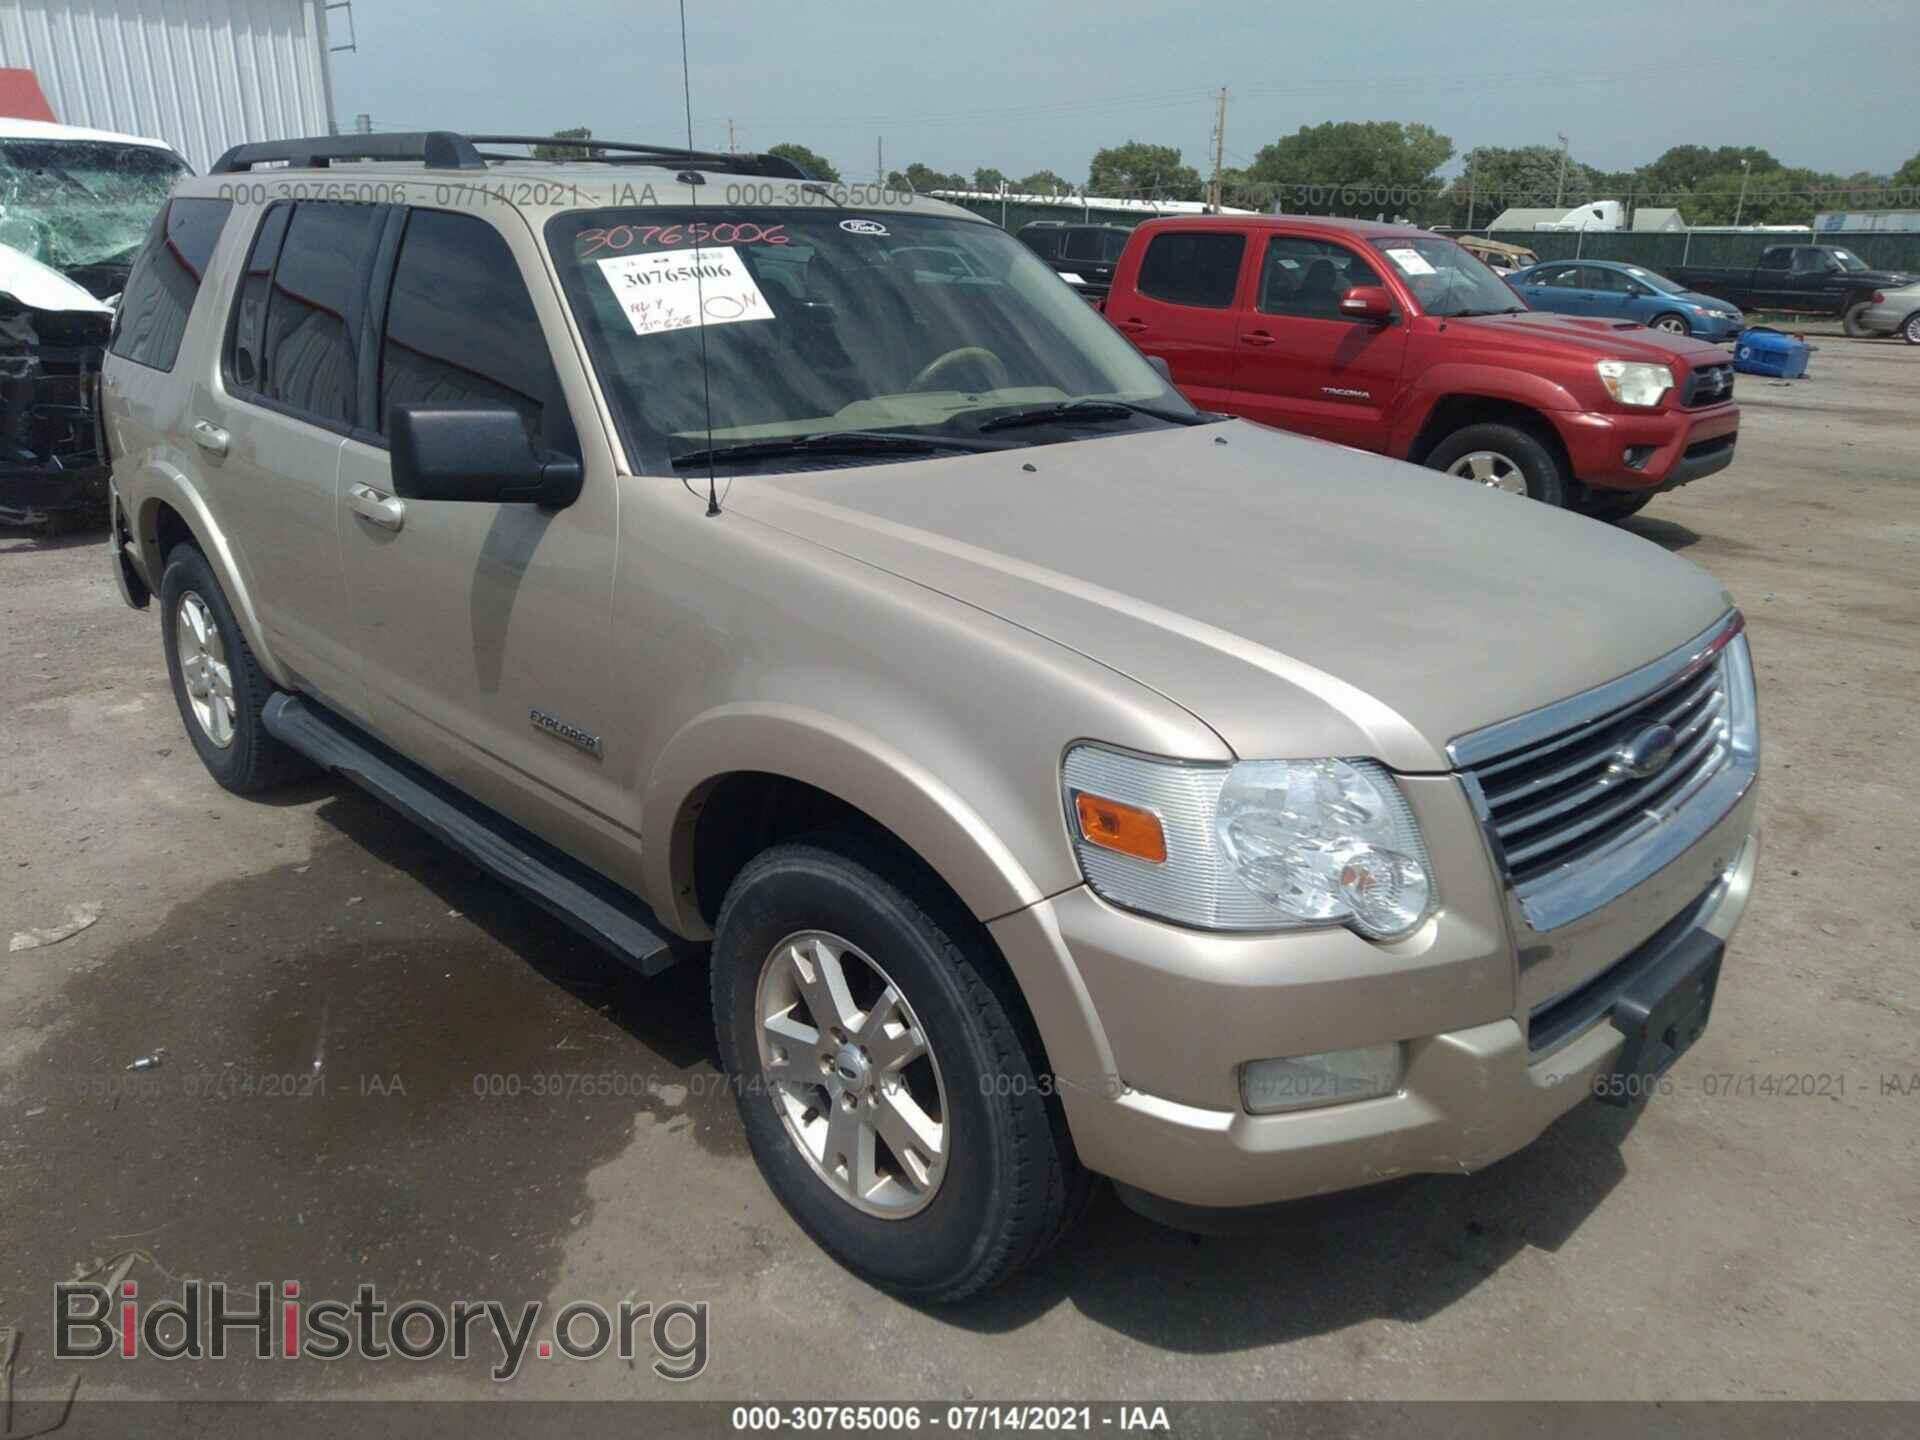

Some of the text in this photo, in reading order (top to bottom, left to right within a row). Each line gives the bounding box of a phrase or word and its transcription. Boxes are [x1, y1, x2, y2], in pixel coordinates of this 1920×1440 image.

[576, 222, 790, 257] 30765006
[623, 263, 732, 288] 30765006
[1320, 386, 1370, 399] TACOMA
[528, 708, 596, 747] EXPLORER
